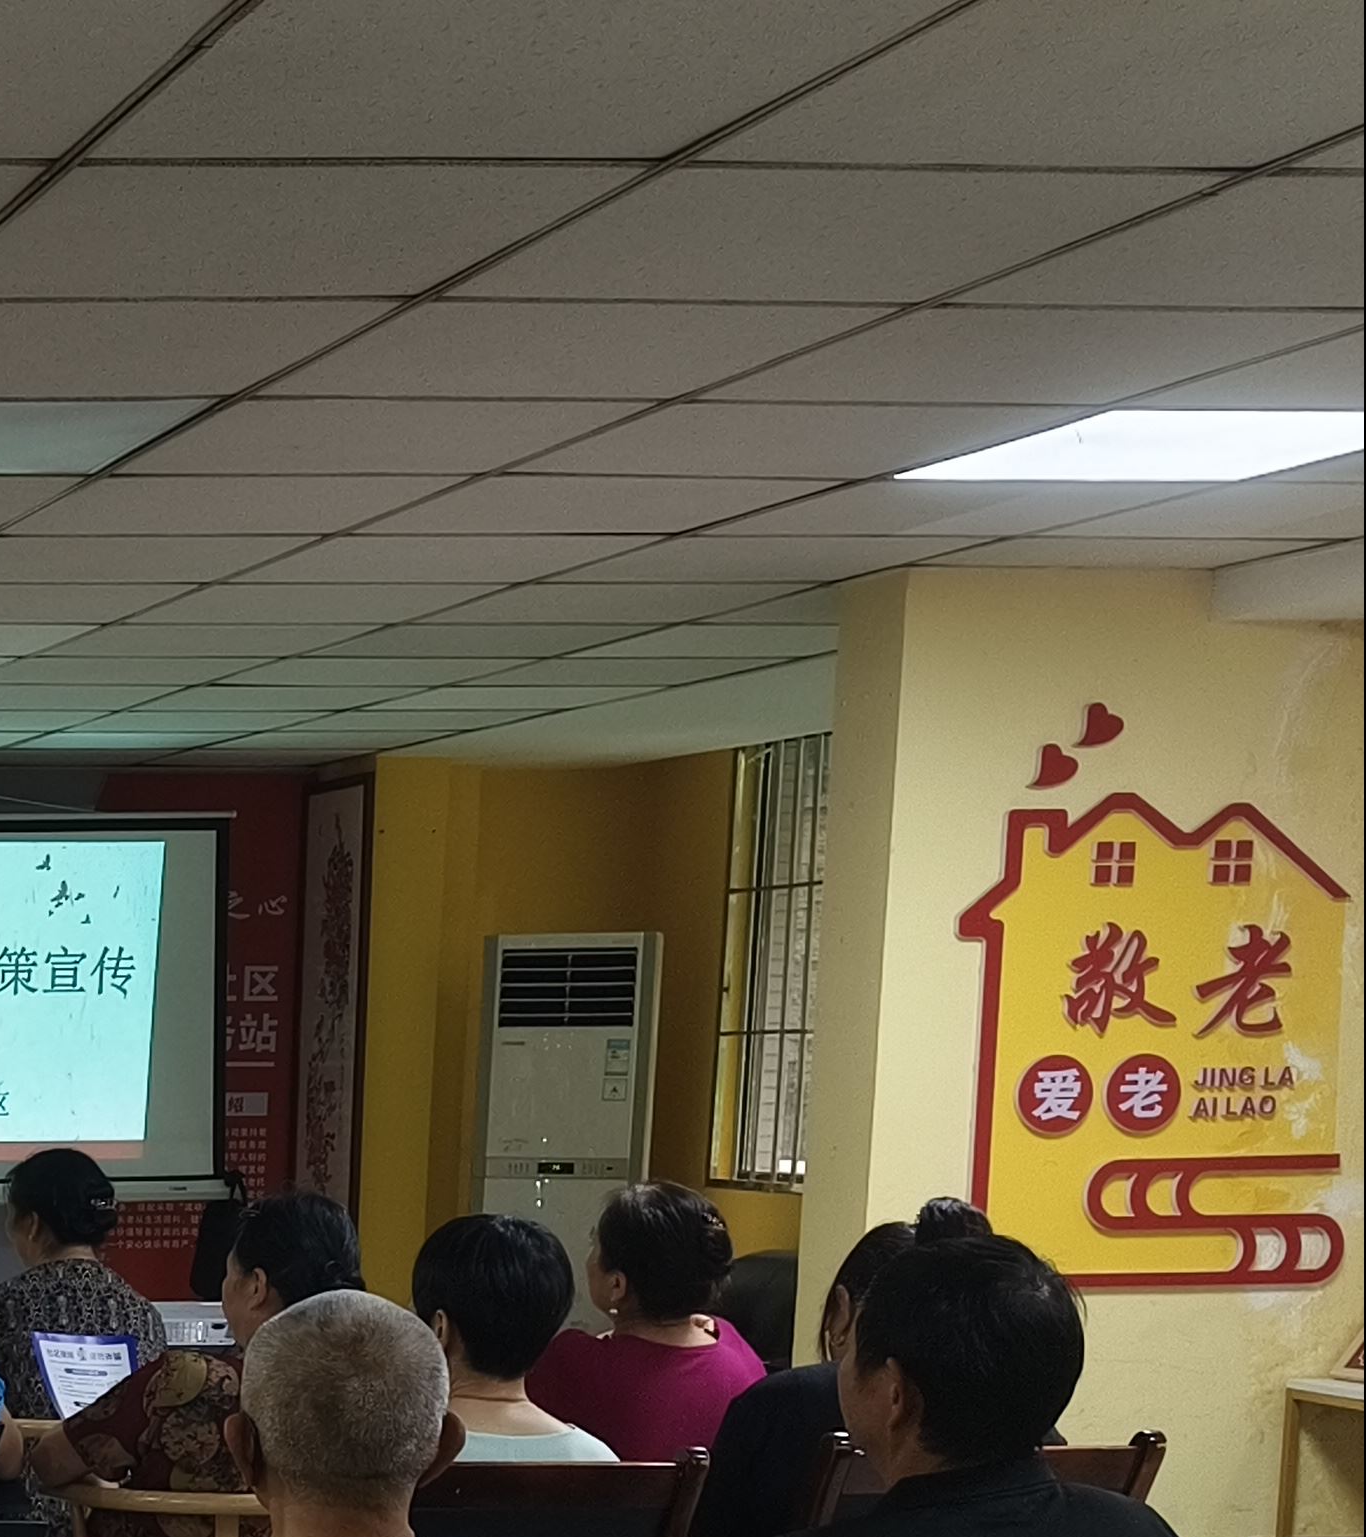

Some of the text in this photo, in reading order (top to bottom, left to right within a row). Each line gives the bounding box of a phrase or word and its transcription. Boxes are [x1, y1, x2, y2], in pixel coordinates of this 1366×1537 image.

[1060, 921, 1294, 1038] 敬老
[1192, 1066, 1255, 1088] JING
[1221, 1096, 1276, 1118] LAO
